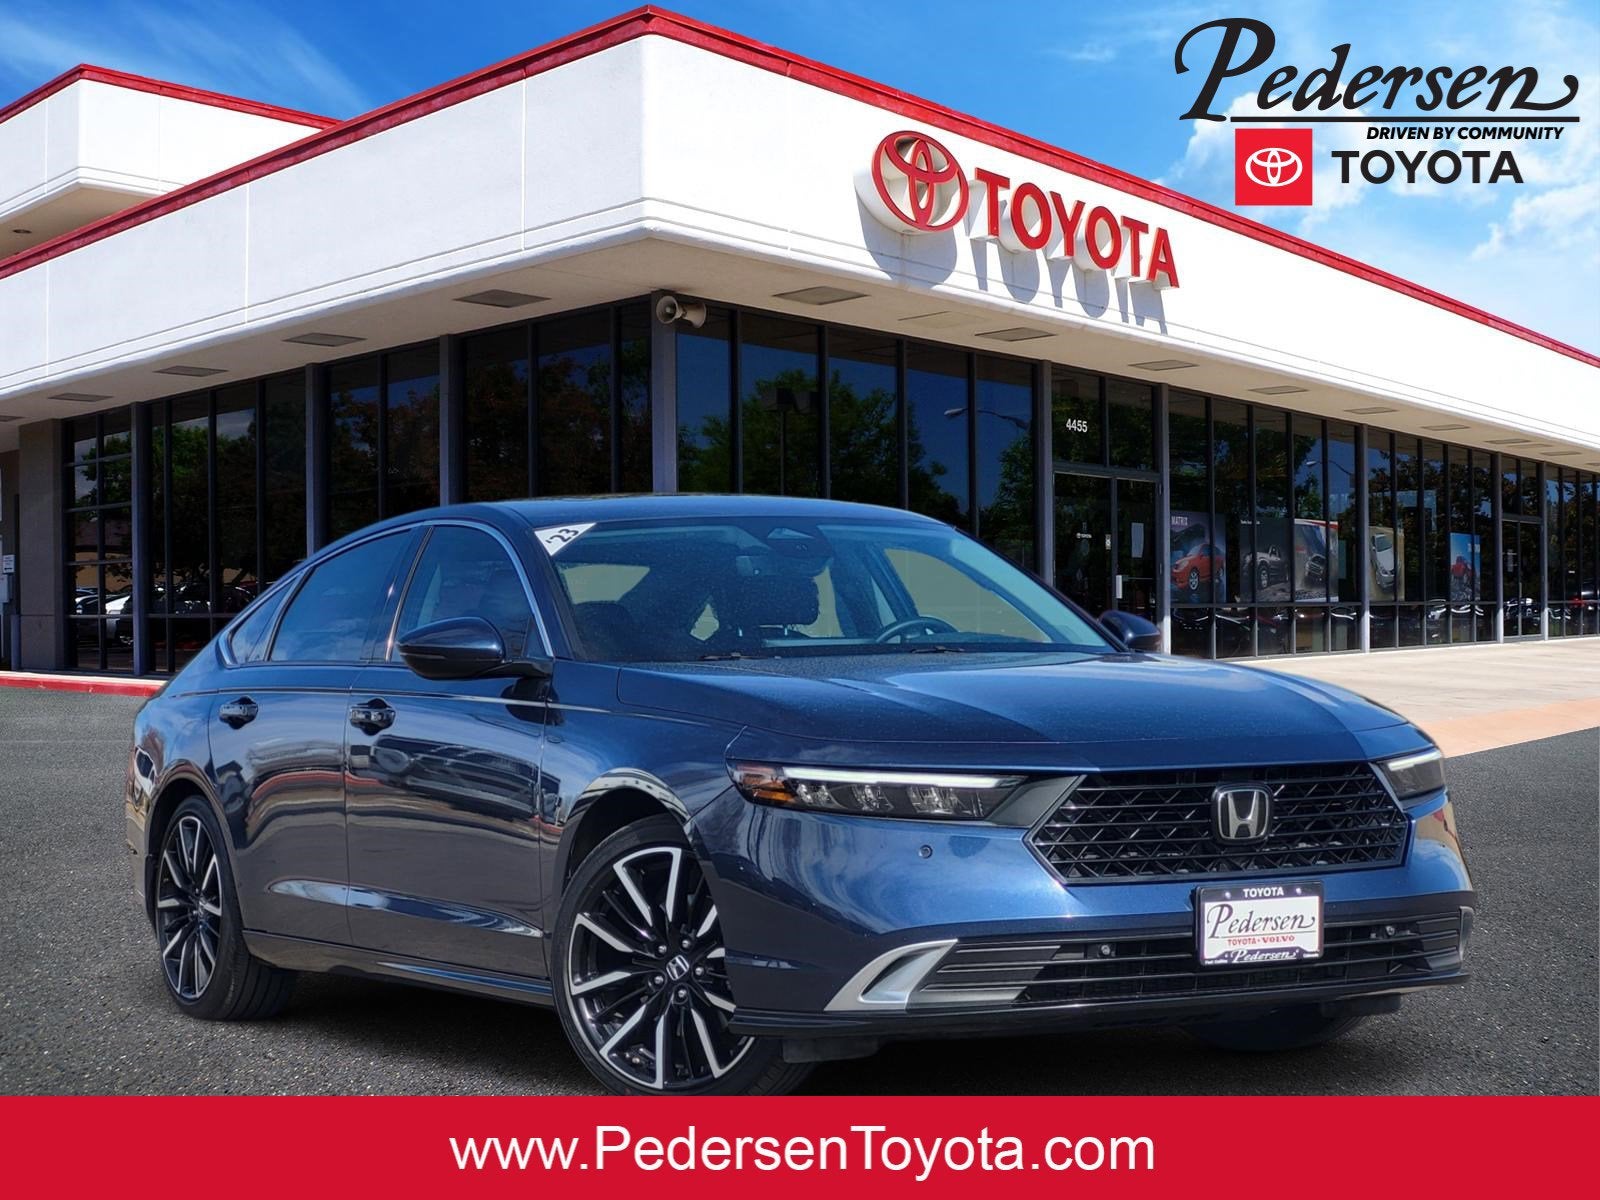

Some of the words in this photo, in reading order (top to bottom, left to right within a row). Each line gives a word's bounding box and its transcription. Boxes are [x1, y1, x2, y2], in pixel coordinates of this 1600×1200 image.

[974, 167, 1180, 289] TOYOTA
[1065, 418, 1088, 433] 4455
[1243, 886, 1284, 898] TOYOTA
[1206, 903, 1316, 939] Pedersen
[1230, 948, 1297, 964] Pedersen
